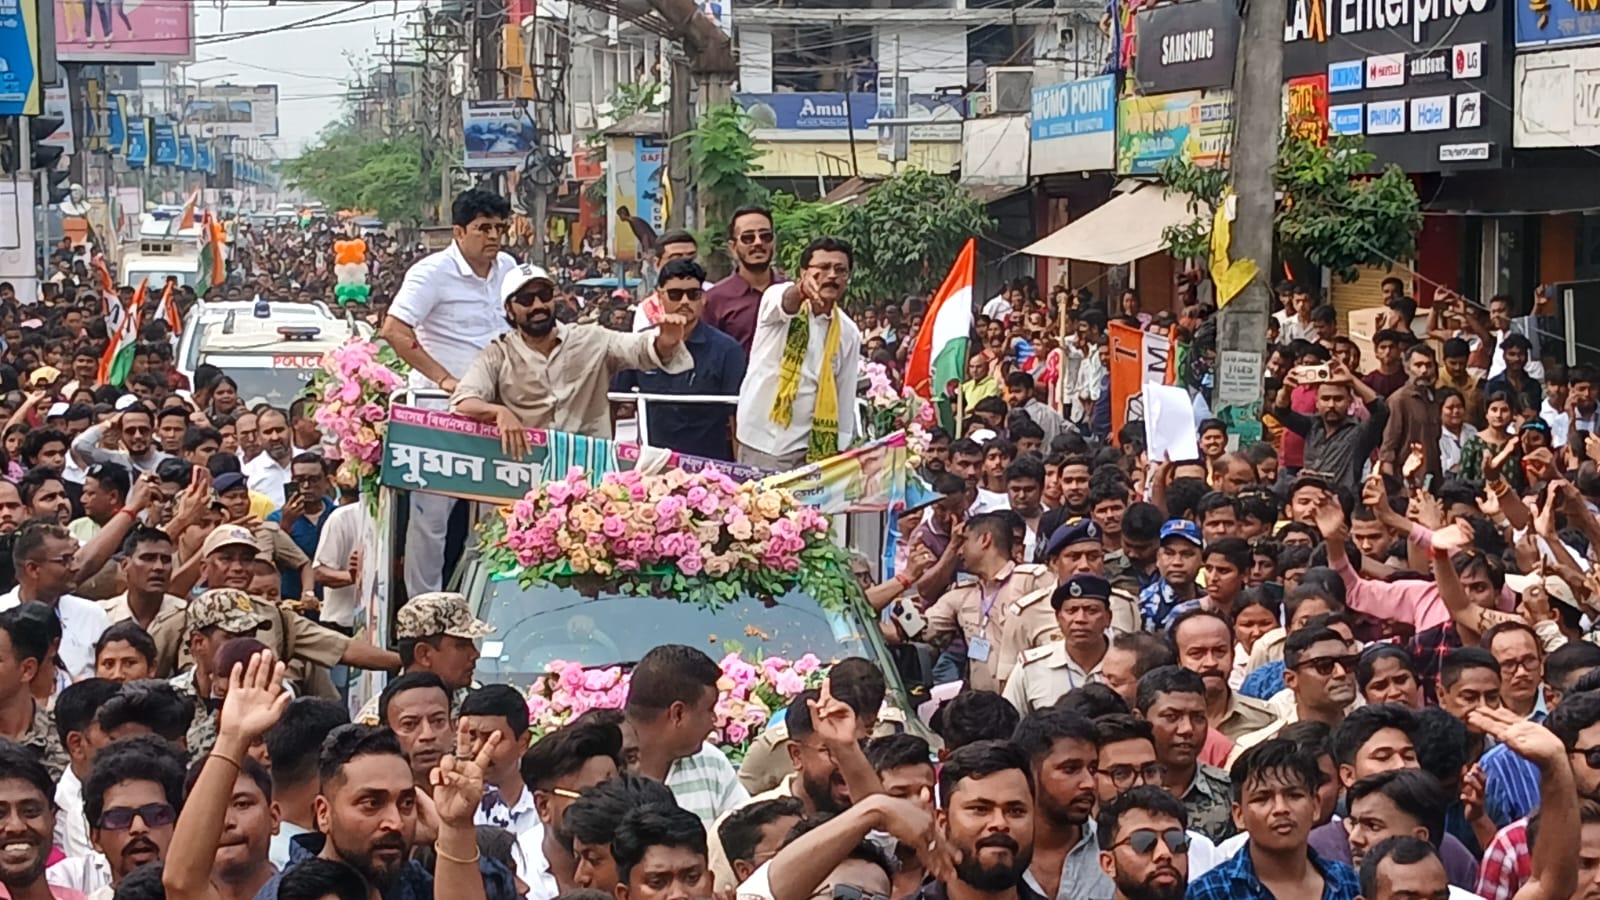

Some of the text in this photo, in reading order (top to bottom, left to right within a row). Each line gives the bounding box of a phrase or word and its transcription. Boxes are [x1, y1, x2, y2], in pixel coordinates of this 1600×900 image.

[1161, 28, 1214, 66] SAMSUNG
[1467, 51, 1478, 70] LG
[799, 98, 848, 118] Amul
[1070, 81, 1112, 116] POINT
[1370, 107, 1401, 127] PHILIPS
[1418, 103, 1443, 127] Haier
[1147, 345, 1169, 373] M
